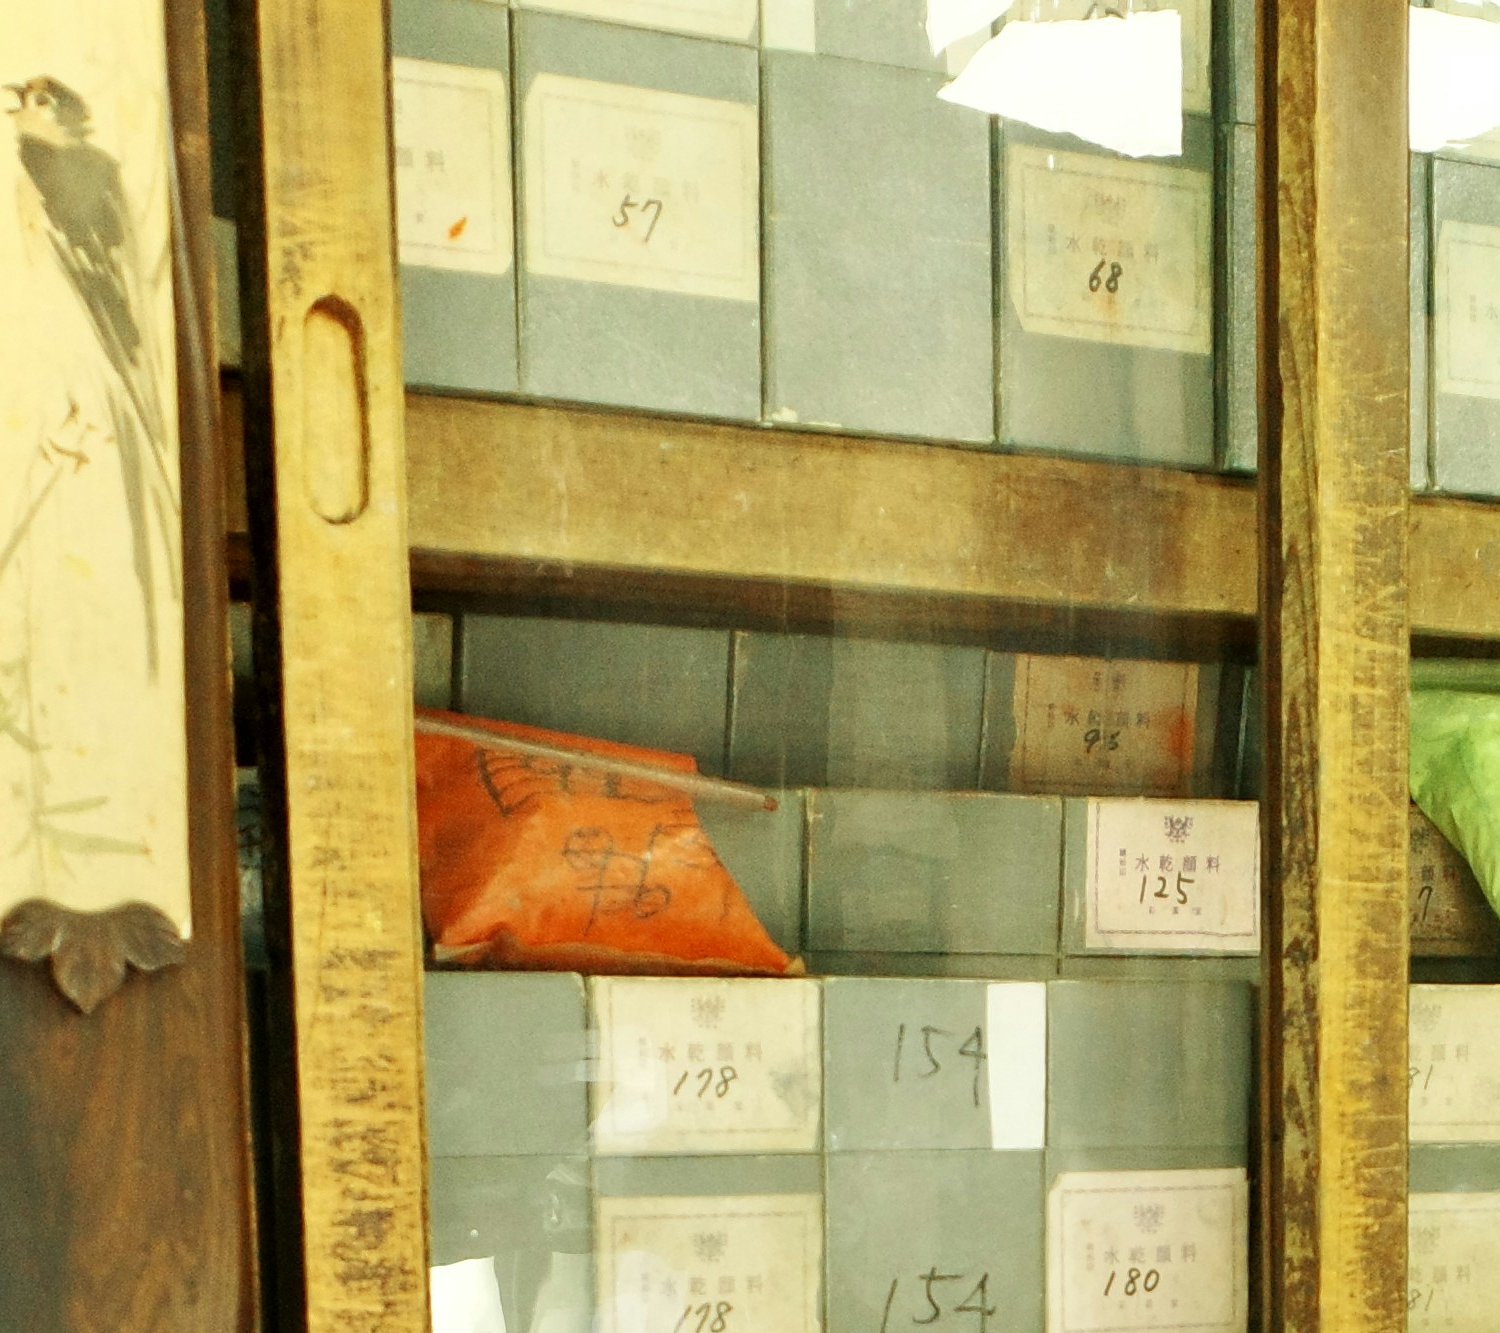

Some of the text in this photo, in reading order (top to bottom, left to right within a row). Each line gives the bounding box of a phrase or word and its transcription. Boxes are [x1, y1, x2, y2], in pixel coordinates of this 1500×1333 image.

[611, 197, 663, 243] 57
[1088, 260, 1123, 294] 68
[1135, 853, 1221, 873] 水乾顔料
[1139, 871, 1195, 905] 125
[893, 1021, 988, 1107] 154
[673, 1065, 738, 1099] 178
[1103, 1267, 1161, 1298] 180
